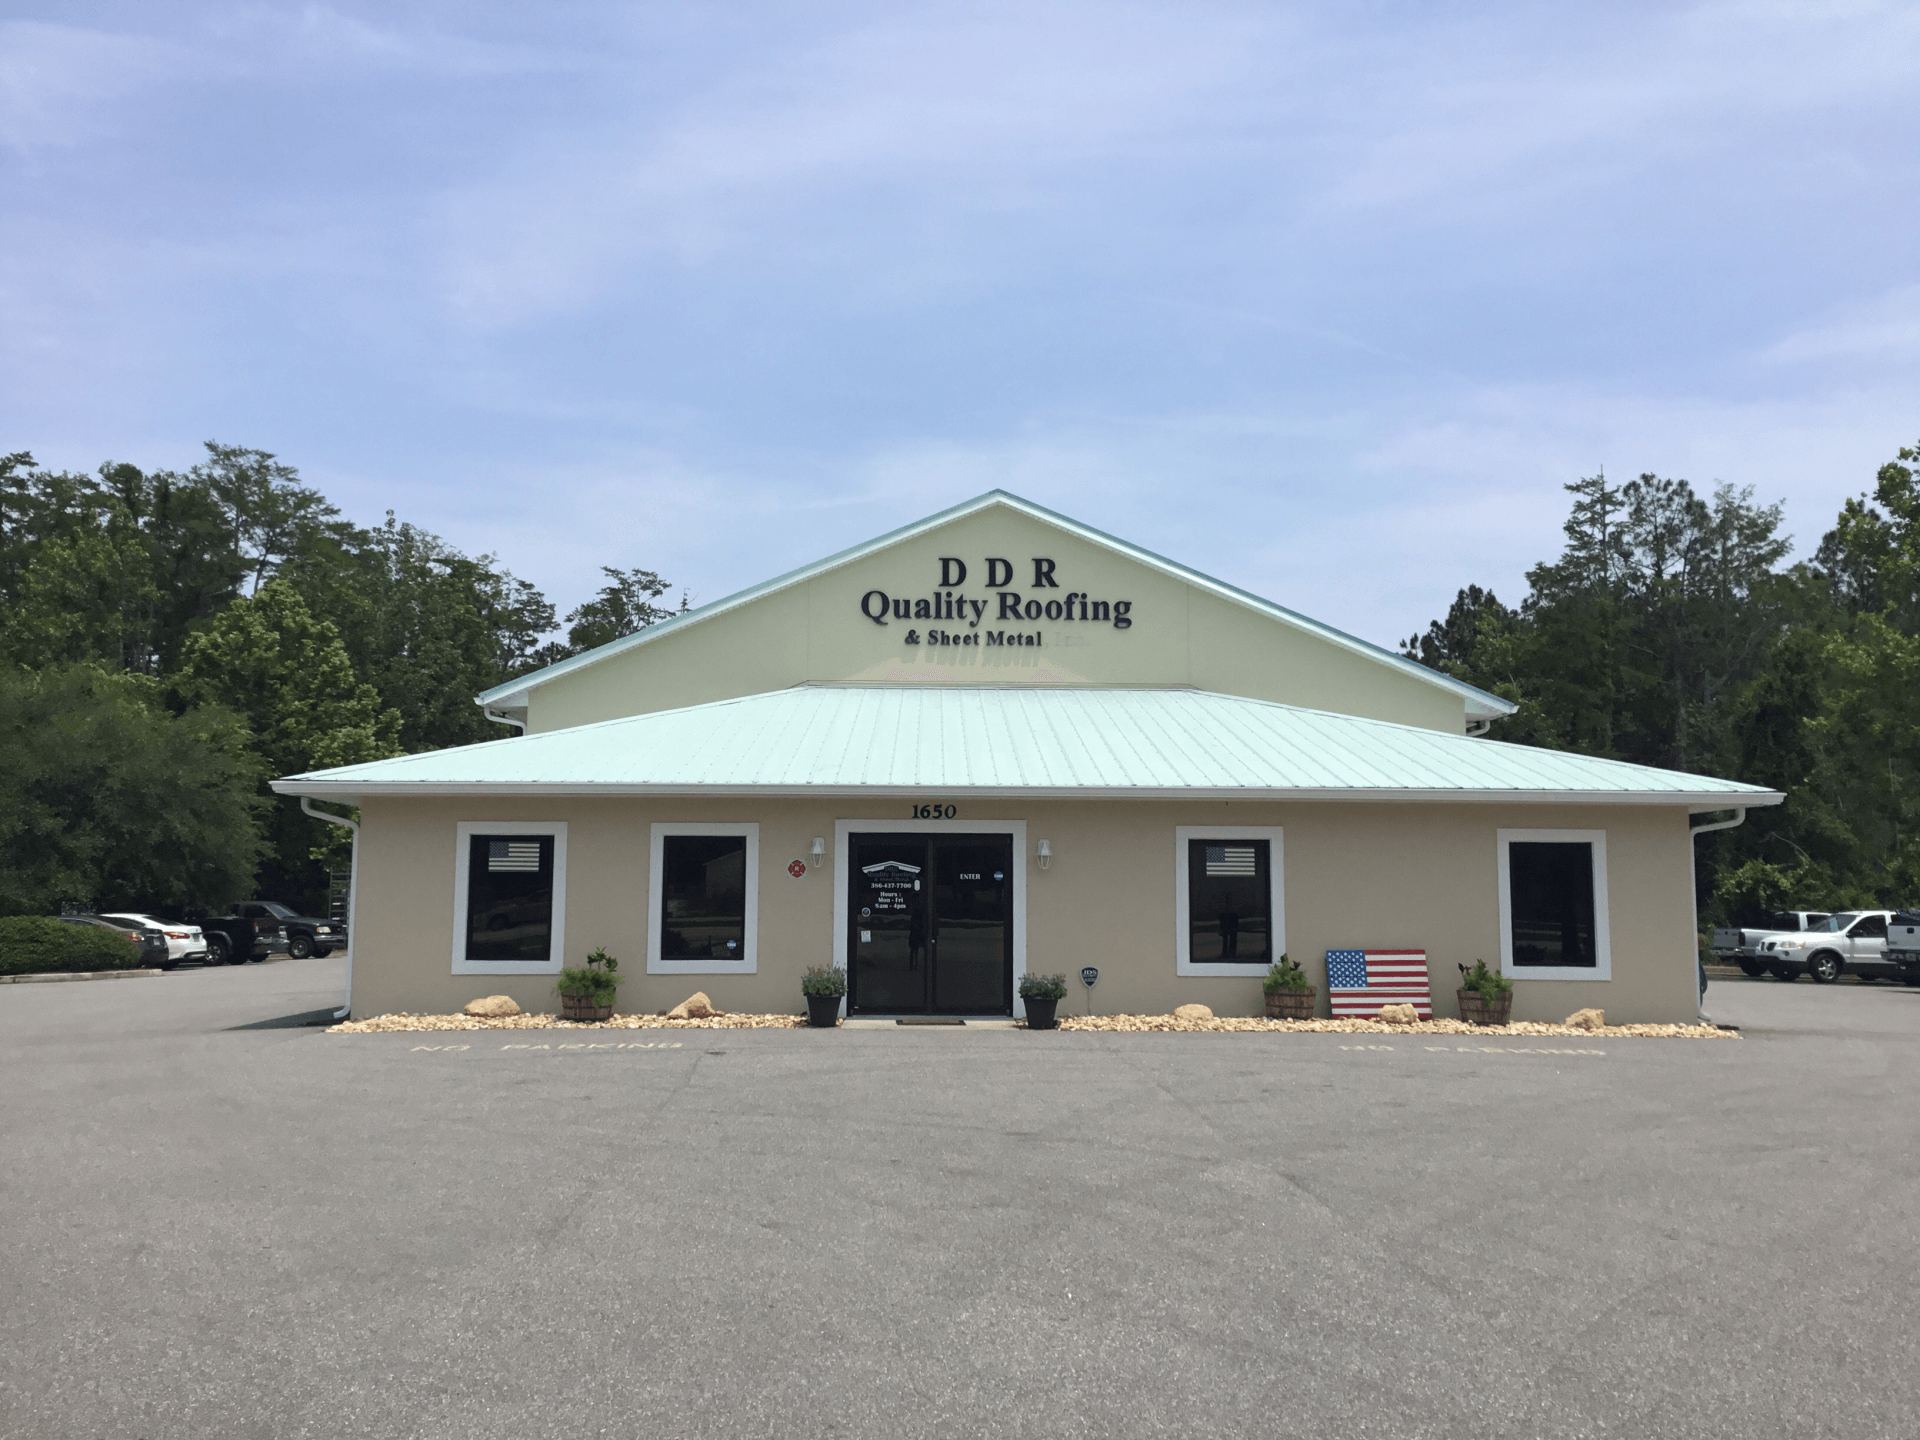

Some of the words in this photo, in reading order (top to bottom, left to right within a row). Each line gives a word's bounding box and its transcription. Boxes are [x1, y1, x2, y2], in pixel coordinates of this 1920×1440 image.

[861, 590, 988, 628] Quality
[996, 592, 1132, 629] Roofing
[904, 629, 920, 645] &
[927, 630, 979, 646] Sheet
[986, 631, 1042, 646] Metal
[912, 804, 957, 819] 1650
